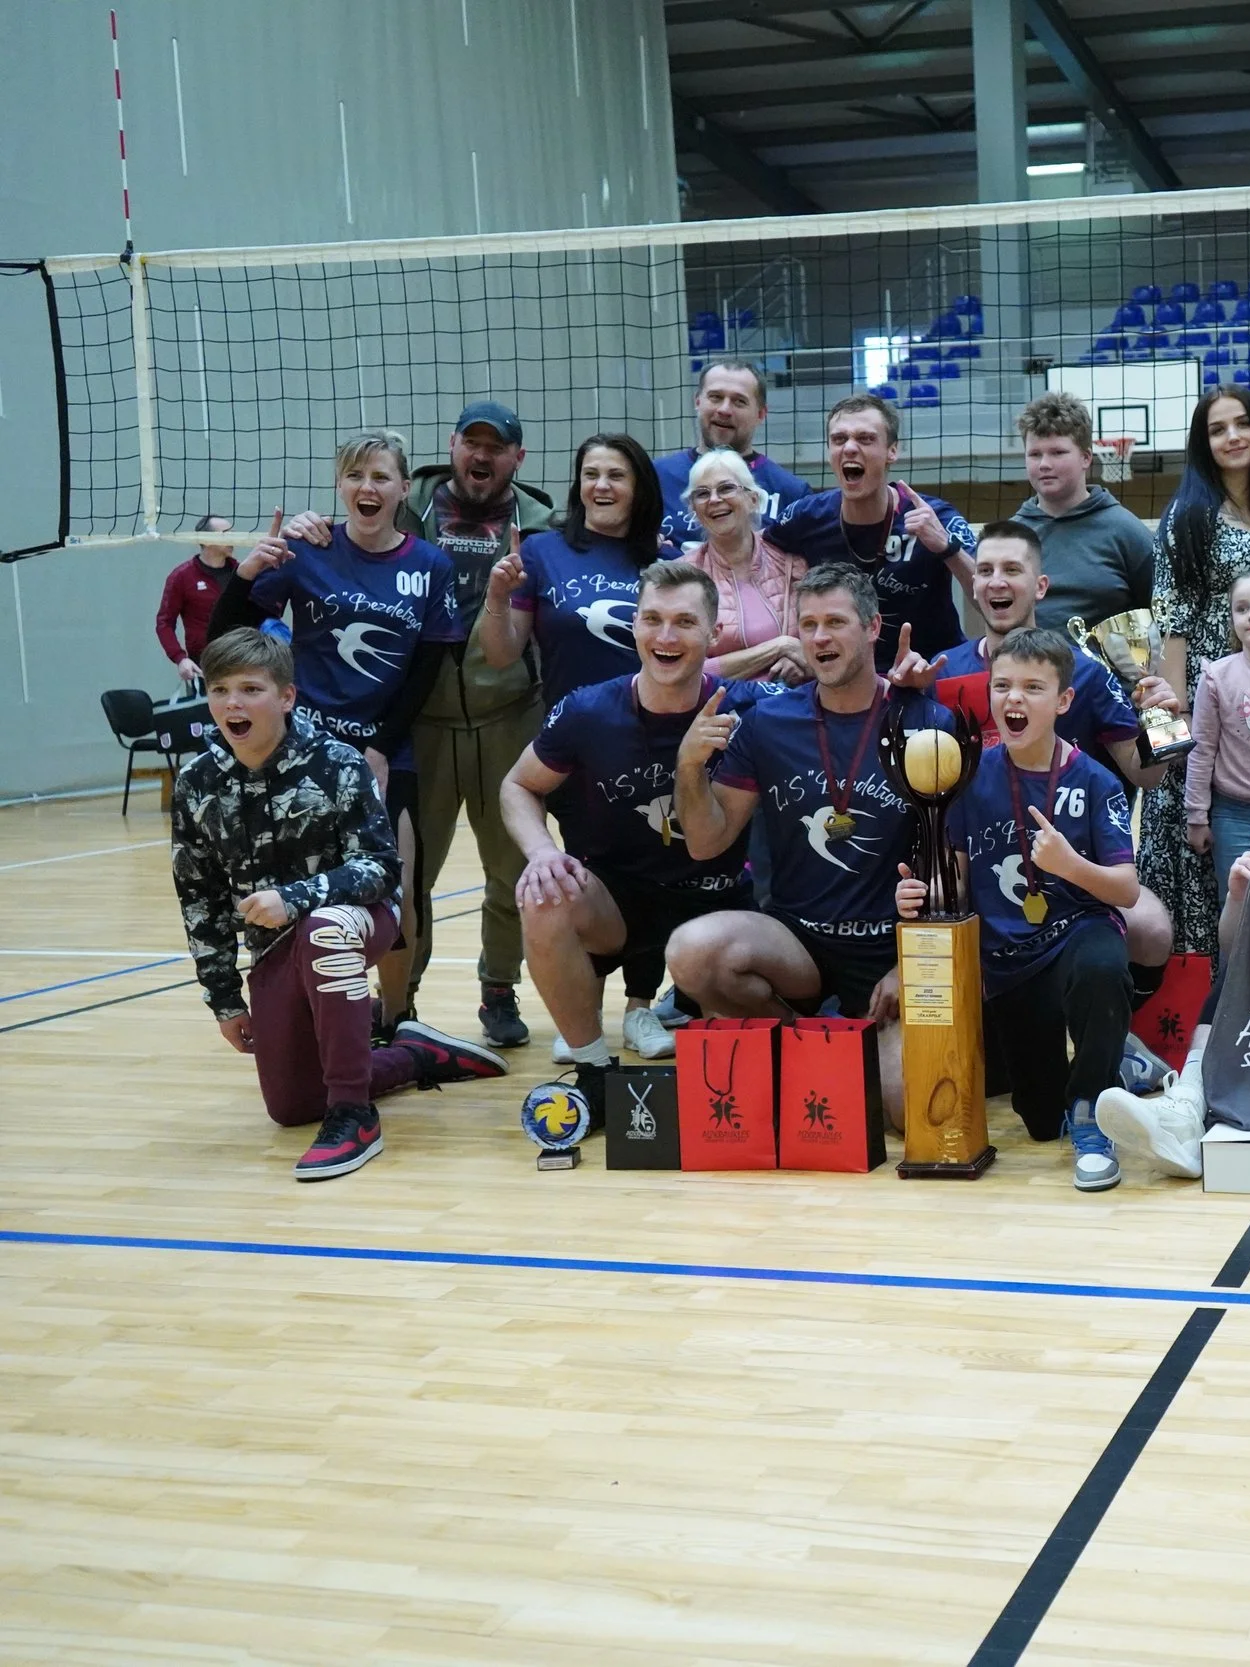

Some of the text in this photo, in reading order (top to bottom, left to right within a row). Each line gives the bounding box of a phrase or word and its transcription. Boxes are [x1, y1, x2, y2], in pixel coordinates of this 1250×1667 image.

[885, 534, 917, 562] 97
[396, 570, 431, 598] 001
[295, 705, 324, 726] SIA
[1054, 787, 1085, 818] 76
[838, 919, 893, 936] BŪVE
